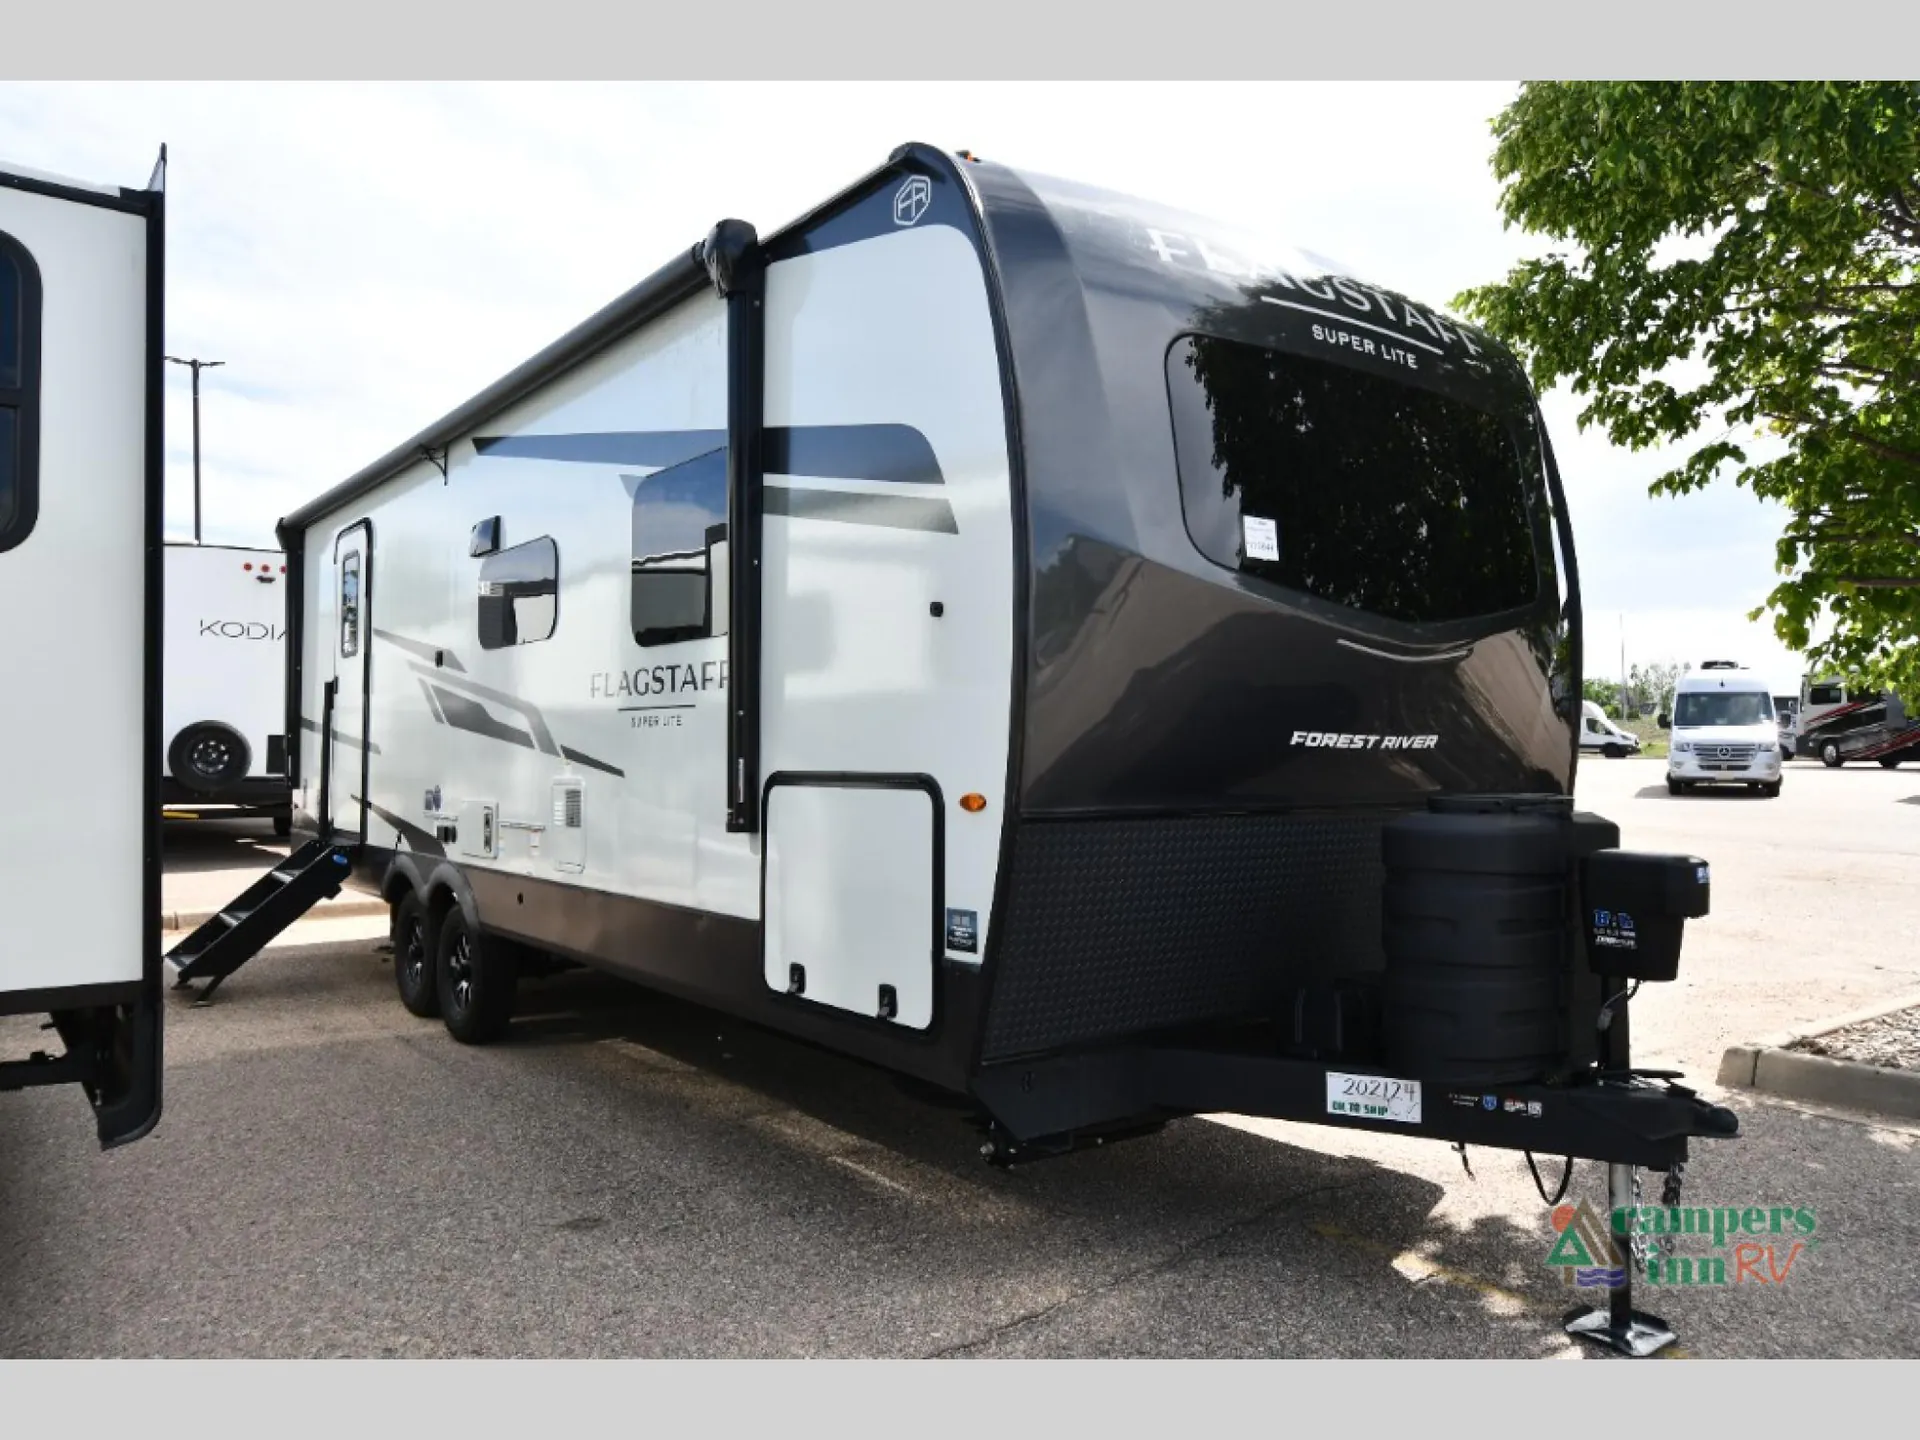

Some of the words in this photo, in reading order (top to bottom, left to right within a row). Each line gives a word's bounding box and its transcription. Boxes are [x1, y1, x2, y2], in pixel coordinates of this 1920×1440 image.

[1311, 323, 1376, 356] SUPER
[1381, 343, 1419, 370] LITE
[631, 716, 660, 728] SUPER
[663, 715, 683, 727] LITE
[1290, 730, 1380, 749] FOREST
[1380, 734, 1439, 749] RIVER
